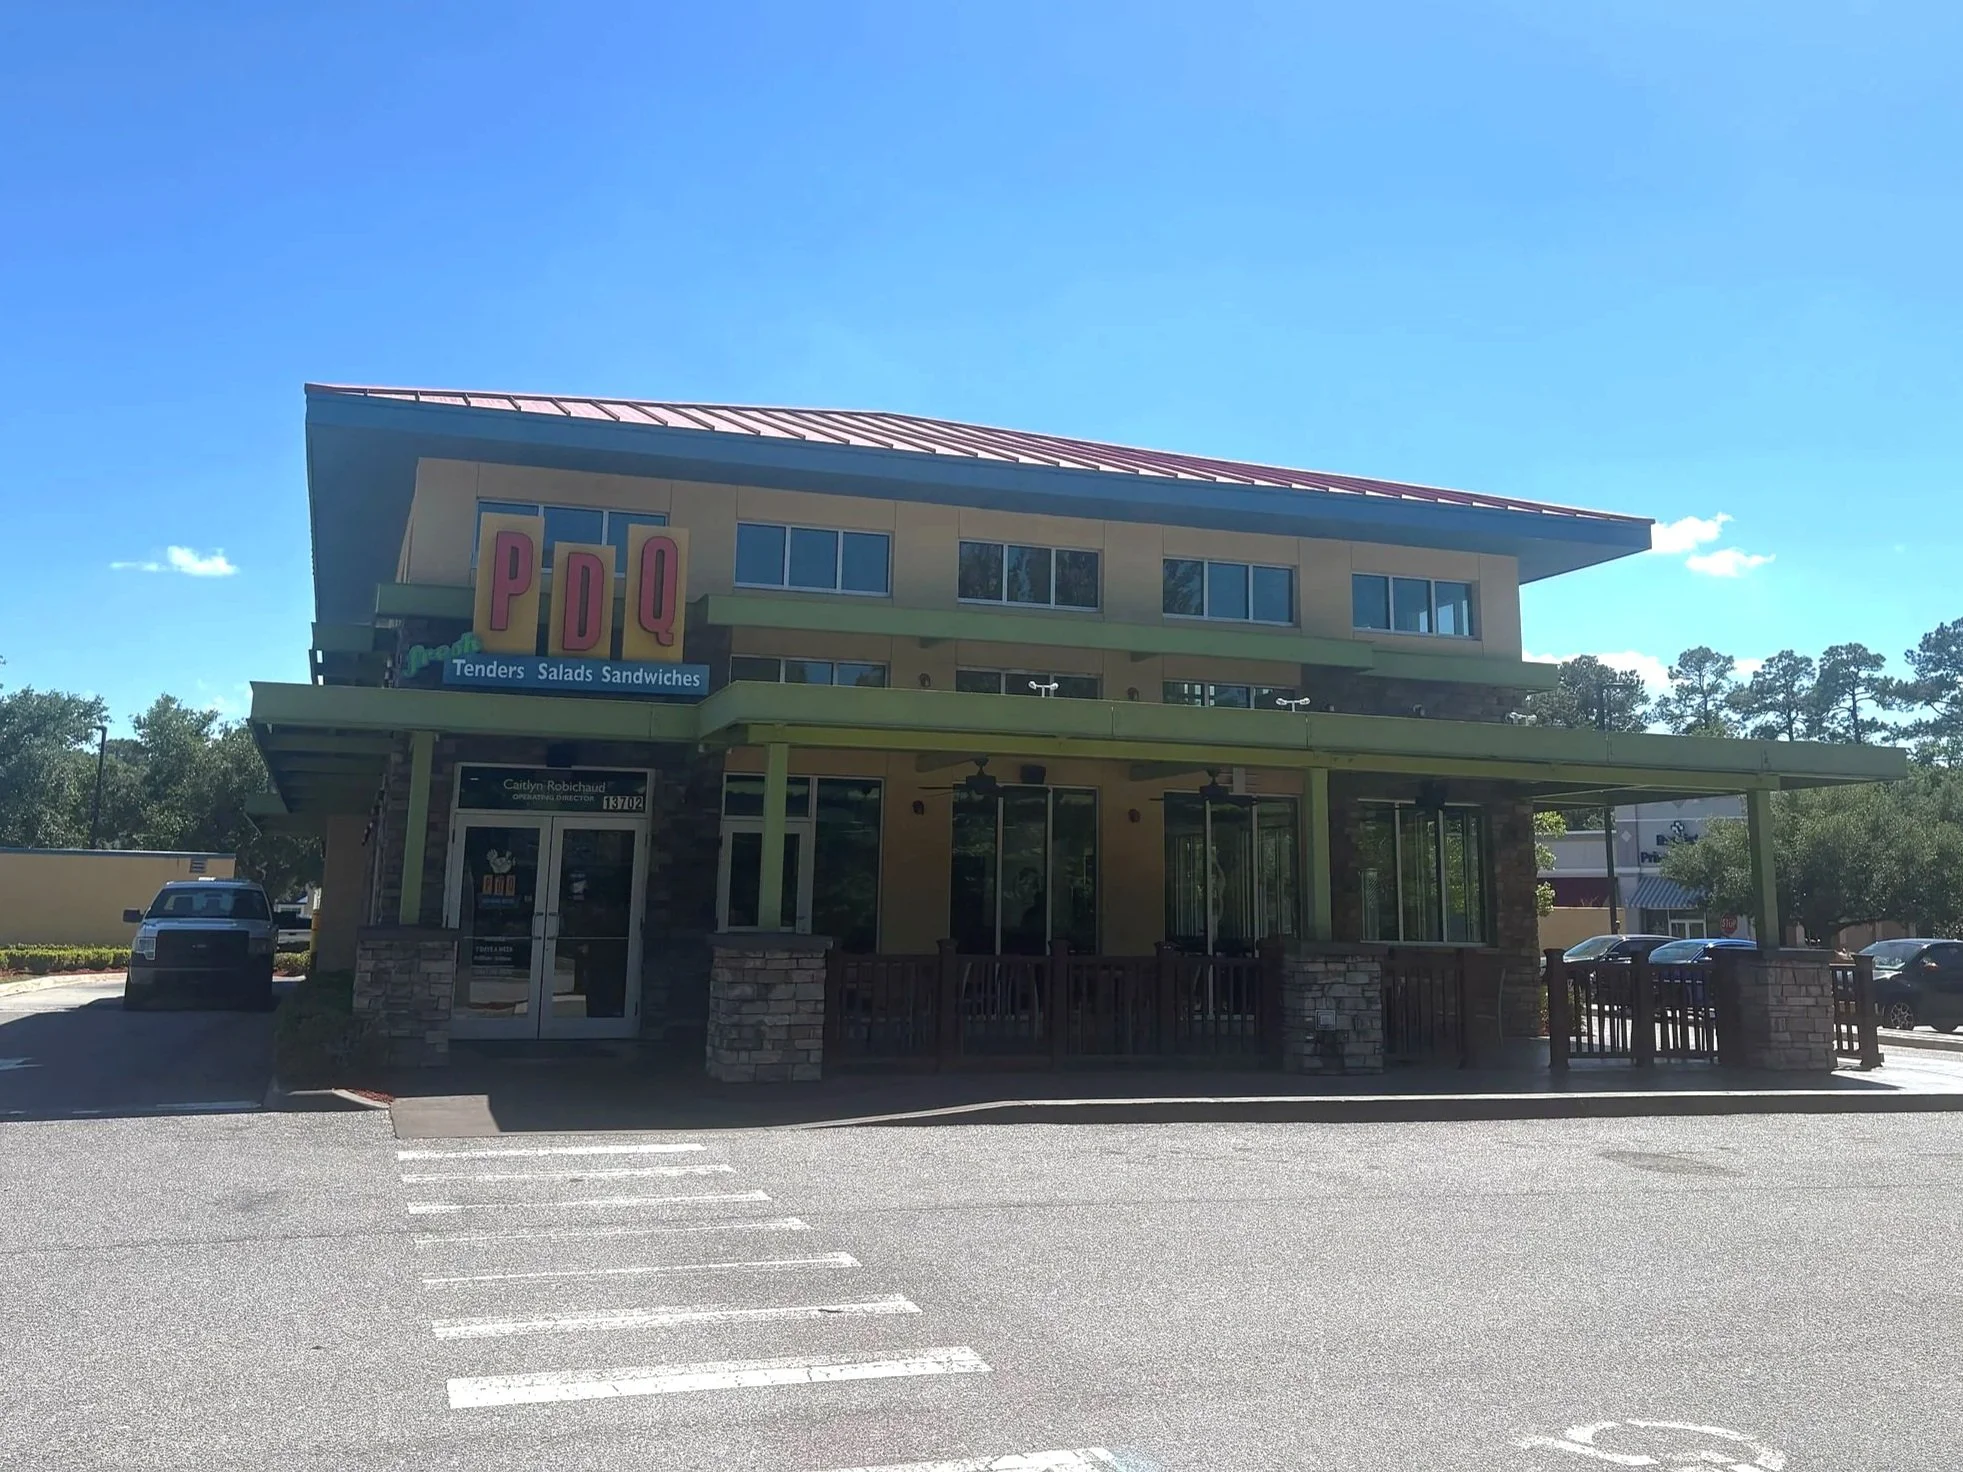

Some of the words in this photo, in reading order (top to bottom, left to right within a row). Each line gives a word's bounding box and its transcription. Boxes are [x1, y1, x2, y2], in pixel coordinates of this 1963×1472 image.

[488, 529, 679, 652] PDQ
[452, 658, 525, 680] Tenders
[537, 662, 593, 683] Salads
[601, 665, 701, 688] Sandwiches
[503, 778, 543, 793] Caitlyn
[547, 780, 606, 793] Robichaud
[512, 793, 554, 801] OPERATING
[555, 794, 595, 802] DIRECTOR
[605, 796, 643, 809] 13702
[1721, 918, 1737, 928] STOP
